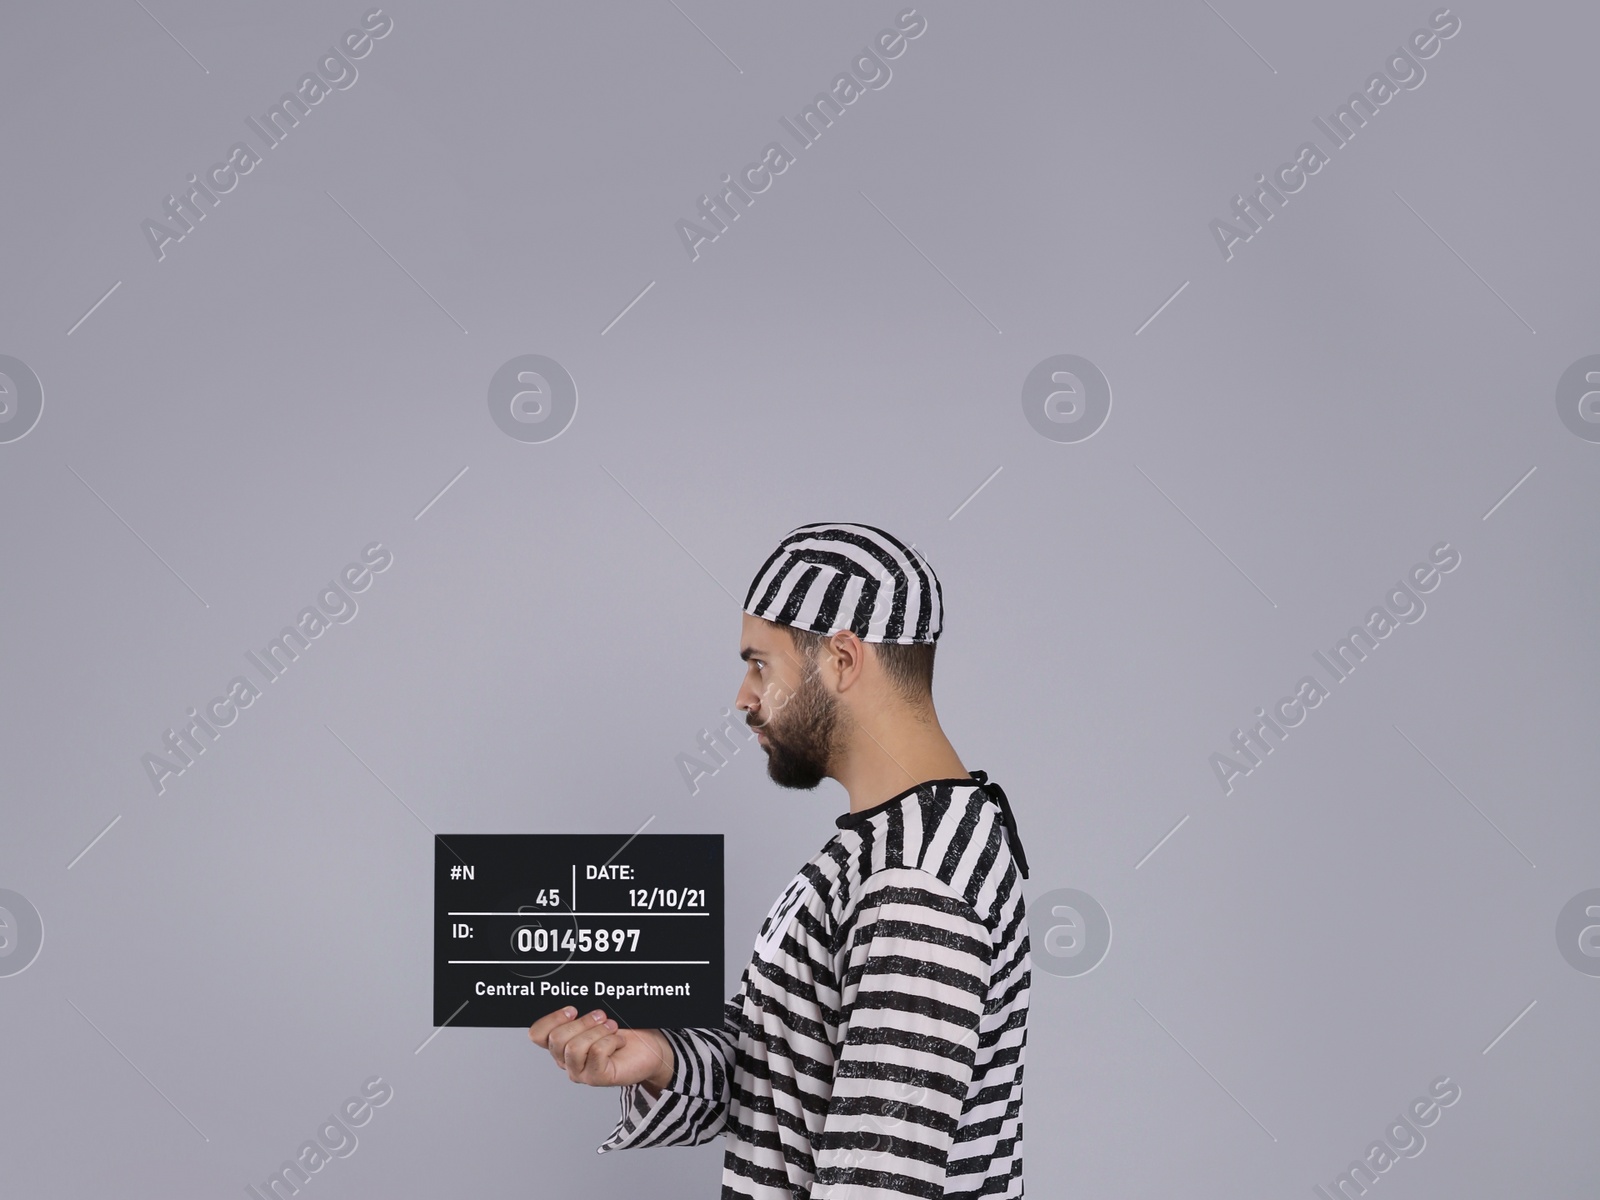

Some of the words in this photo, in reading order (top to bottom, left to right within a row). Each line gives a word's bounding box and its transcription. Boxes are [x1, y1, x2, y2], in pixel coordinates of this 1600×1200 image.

[451, 866, 474, 880] #N
[587, 865, 634, 879] DATE:
[536, 889, 559, 906] 45
[630, 888, 704, 909] 12/10/21
[453, 924, 473, 938] ID:
[518, 929, 640, 952] 00145897
[476, 982, 534, 995] Central
[541, 982, 588, 995] Police
[595, 982, 690, 999] Department
